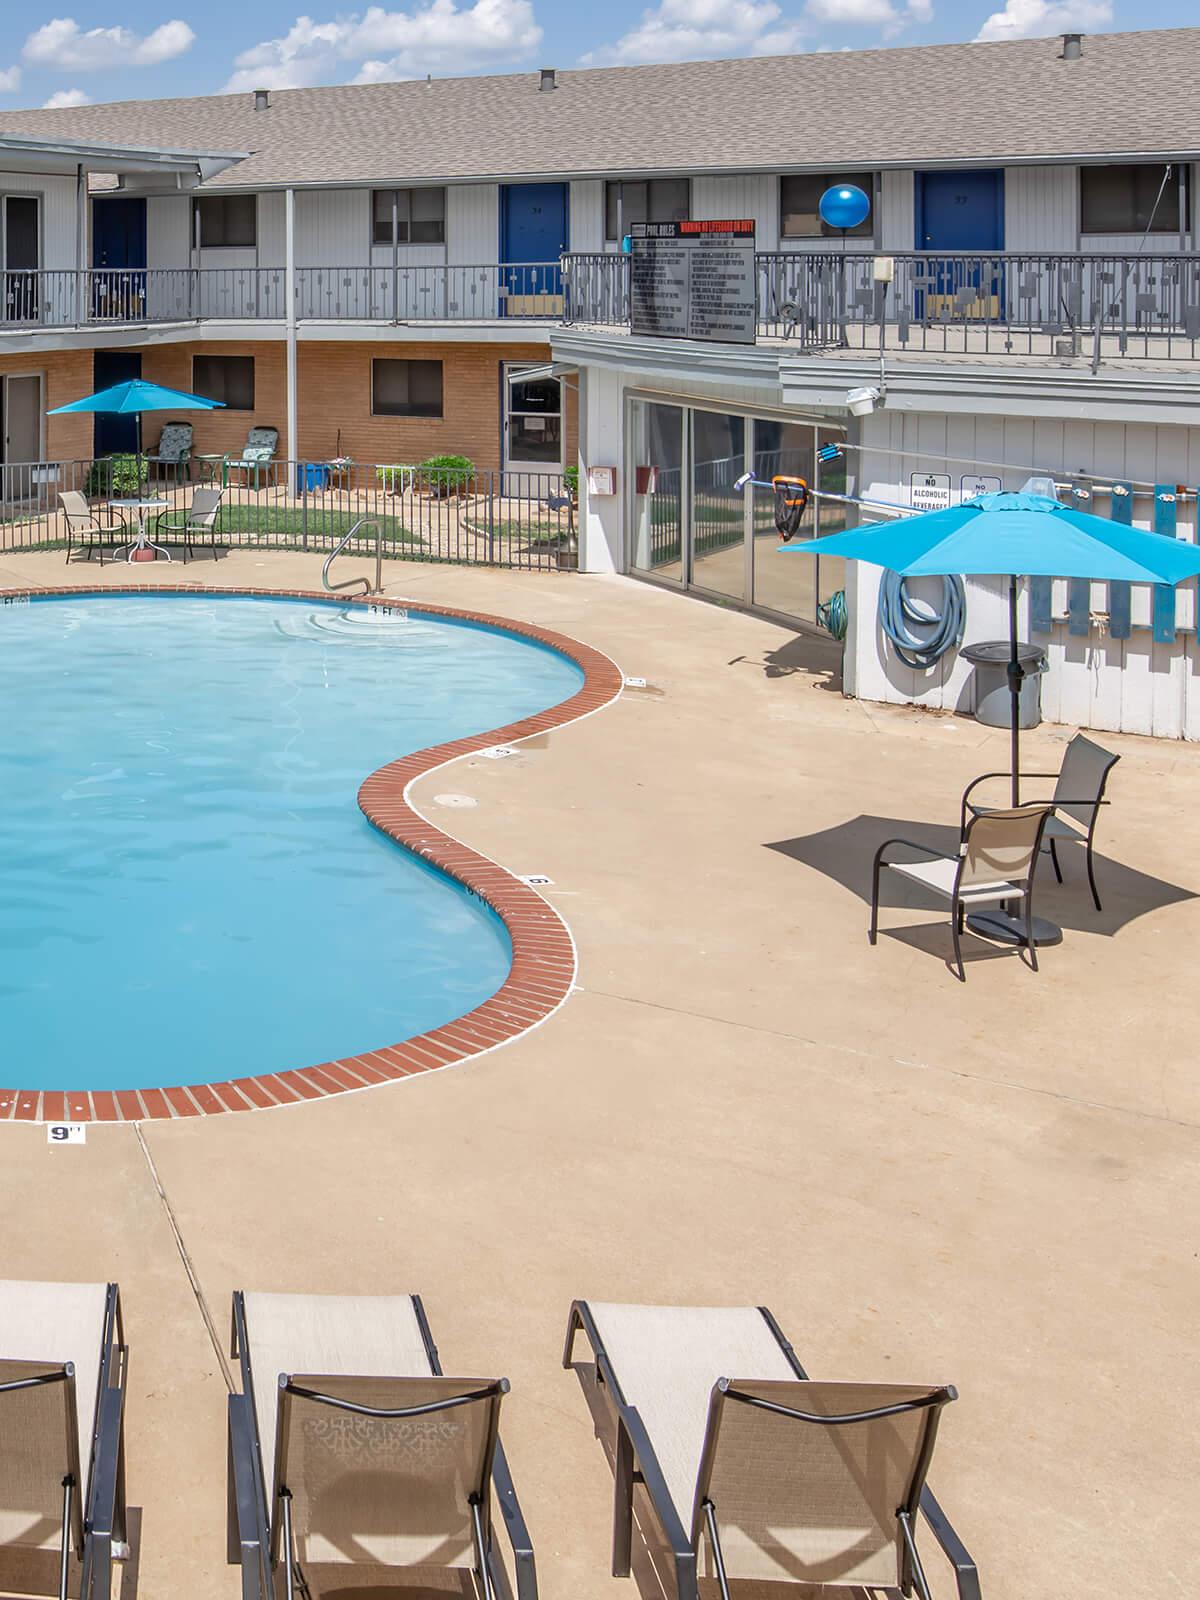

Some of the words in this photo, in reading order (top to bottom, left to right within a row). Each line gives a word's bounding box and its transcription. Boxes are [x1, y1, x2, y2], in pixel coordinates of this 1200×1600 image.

[647, 224, 658, 237] POOL
[659, 224, 675, 236] RULES
[925, 479, 936, 487] NO
[913, 490, 948, 499] ALCOHOLIC
